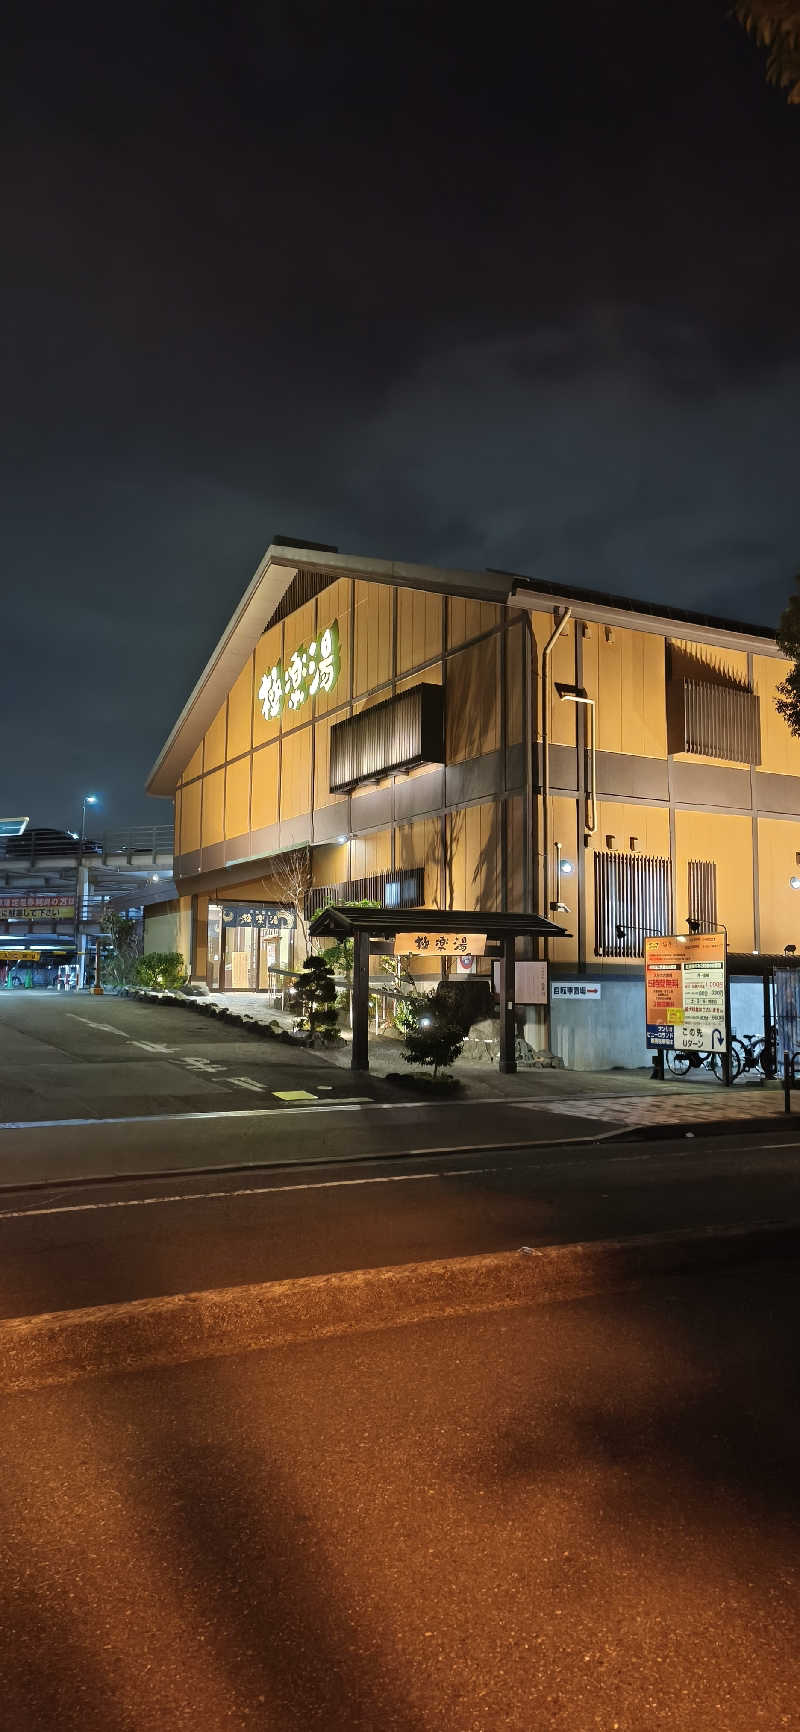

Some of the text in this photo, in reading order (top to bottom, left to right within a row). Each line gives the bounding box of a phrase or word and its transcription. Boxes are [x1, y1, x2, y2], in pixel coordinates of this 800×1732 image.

[258, 628, 334, 720] 極楽湯
[414, 935, 468, 952] 極楽湯
[683, 1027, 703, 1038] この先
[682, 1039, 704, 1048] Uターン
